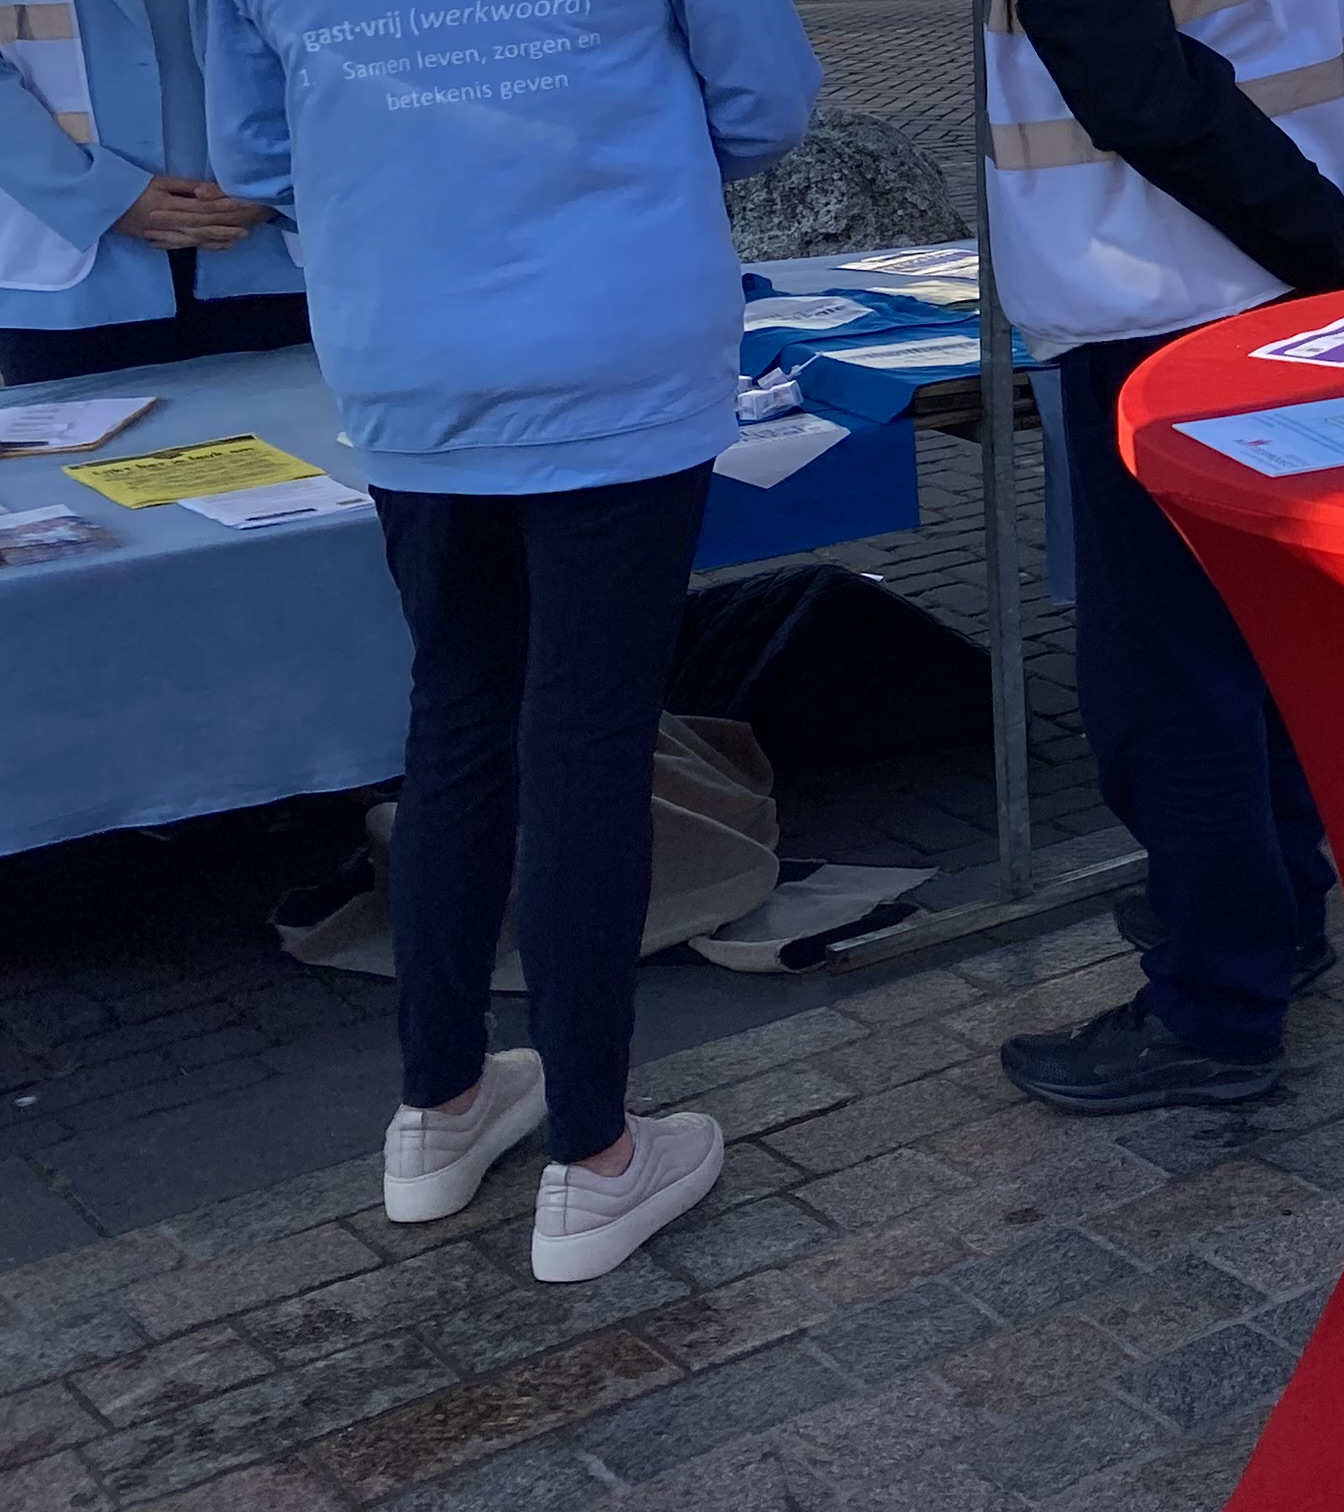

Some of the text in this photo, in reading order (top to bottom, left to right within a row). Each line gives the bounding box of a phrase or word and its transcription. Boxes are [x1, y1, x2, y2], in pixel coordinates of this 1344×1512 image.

[343, 59, 411, 81] Samen
[417, 46, 487, 70] leven,
[493, 37, 571, 63] zorgen
[577, 31, 601, 49] en
[386, 72, 569, 112] betekenis geven
